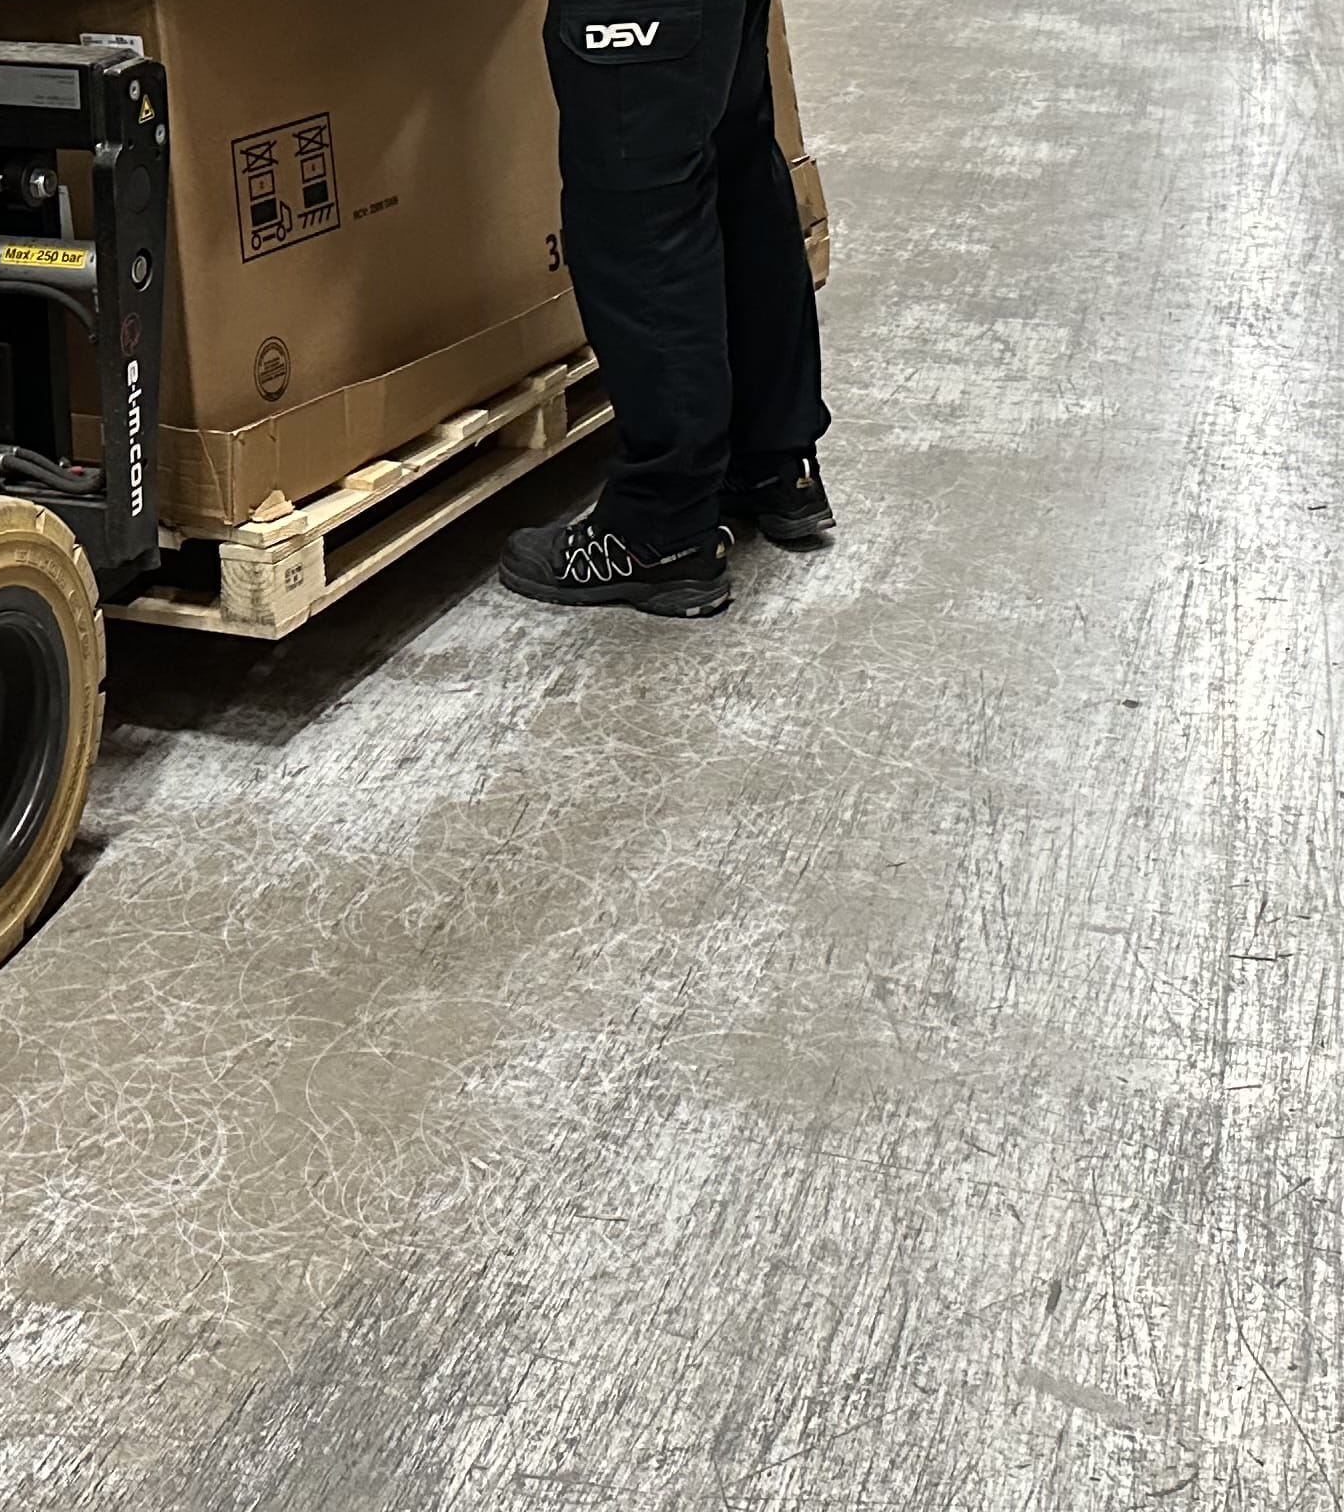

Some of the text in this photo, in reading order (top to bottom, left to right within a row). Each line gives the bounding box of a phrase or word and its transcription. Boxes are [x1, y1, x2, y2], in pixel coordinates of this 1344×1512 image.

[586, 21, 659, 49] DSV
[36, 250, 58, 262] 250
[61, 251, 83, 263] bar
